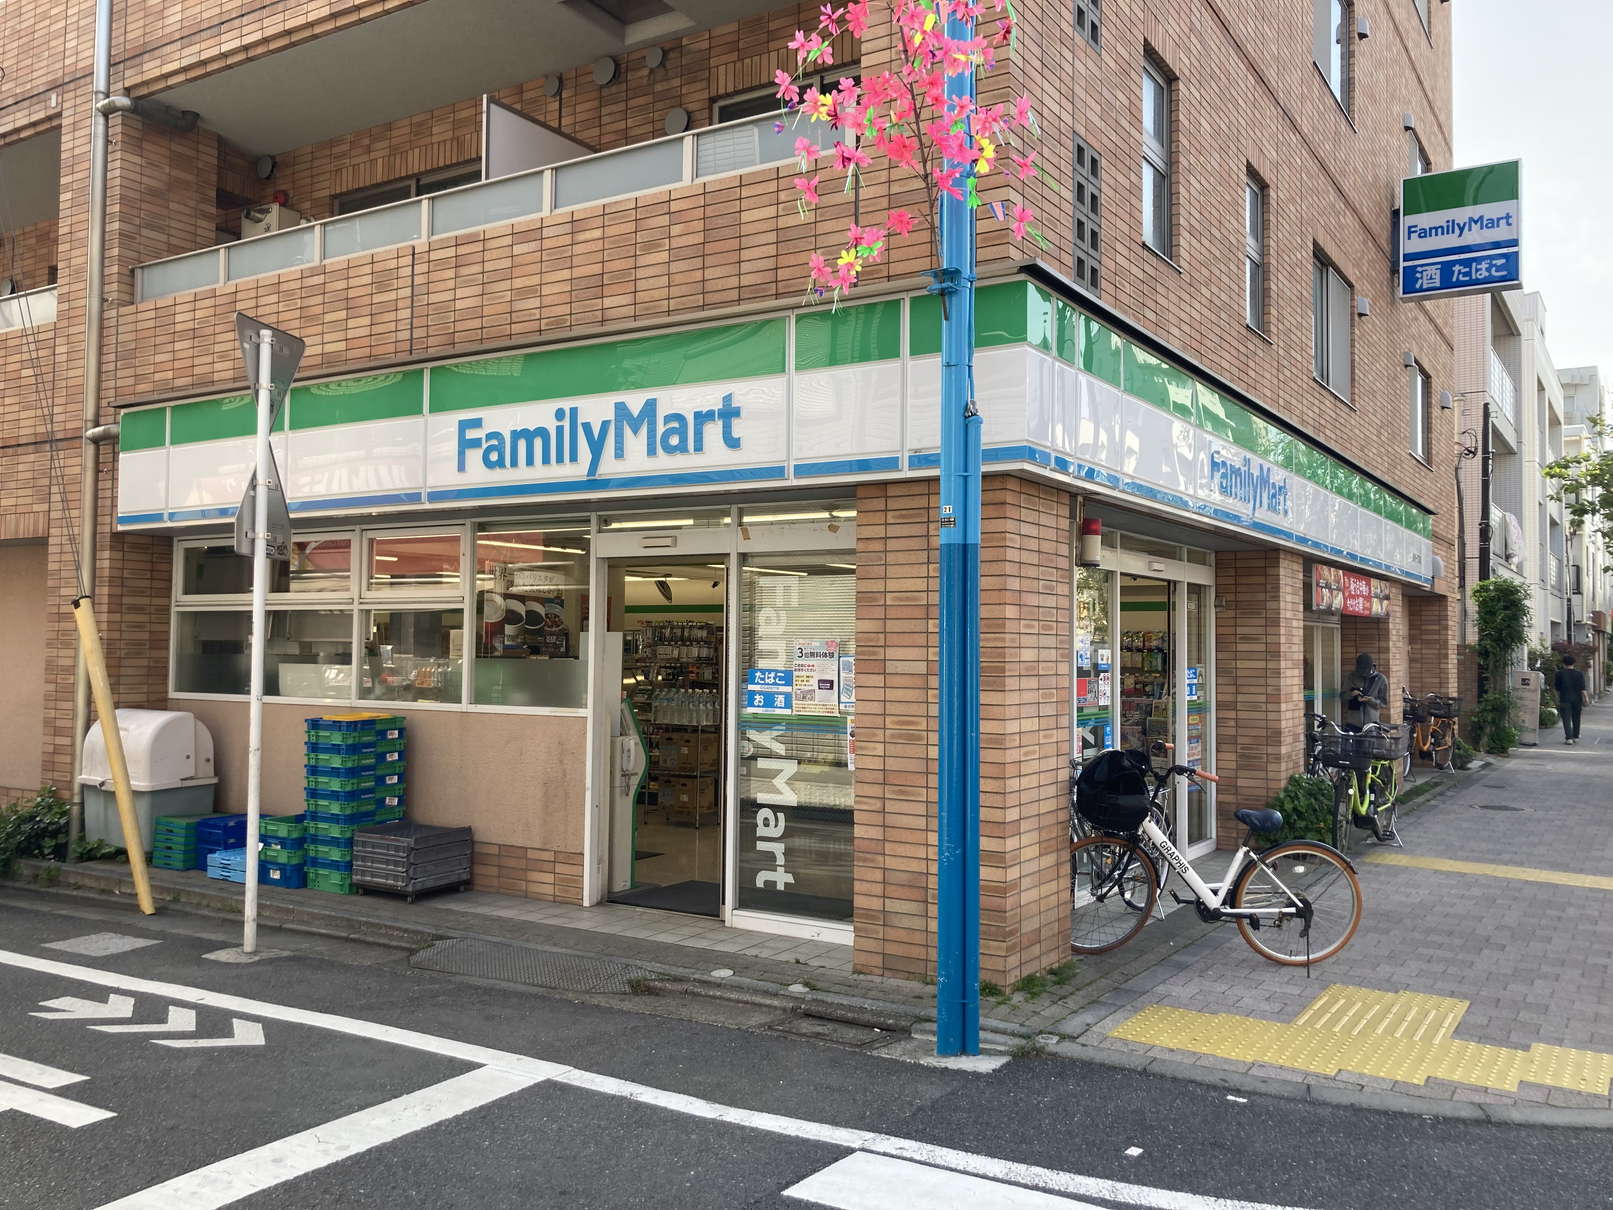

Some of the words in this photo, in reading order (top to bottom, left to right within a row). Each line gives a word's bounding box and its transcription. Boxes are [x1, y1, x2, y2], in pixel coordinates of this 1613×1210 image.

[1407, 212, 1513, 241] FamilyMart
[1415, 264, 1442, 289] 酒
[1451, 258, 1508, 282] たばこ
[457, 391, 741, 479] FamilyMart
[1210, 449, 1288, 519] FamilyMart
[754, 671, 786, 684] たばこ
[753, 694, 785, 707] お酒
[746, 576, 800, 891] FamyMart
[1159, 840, 1190, 874] GRAPHIS
